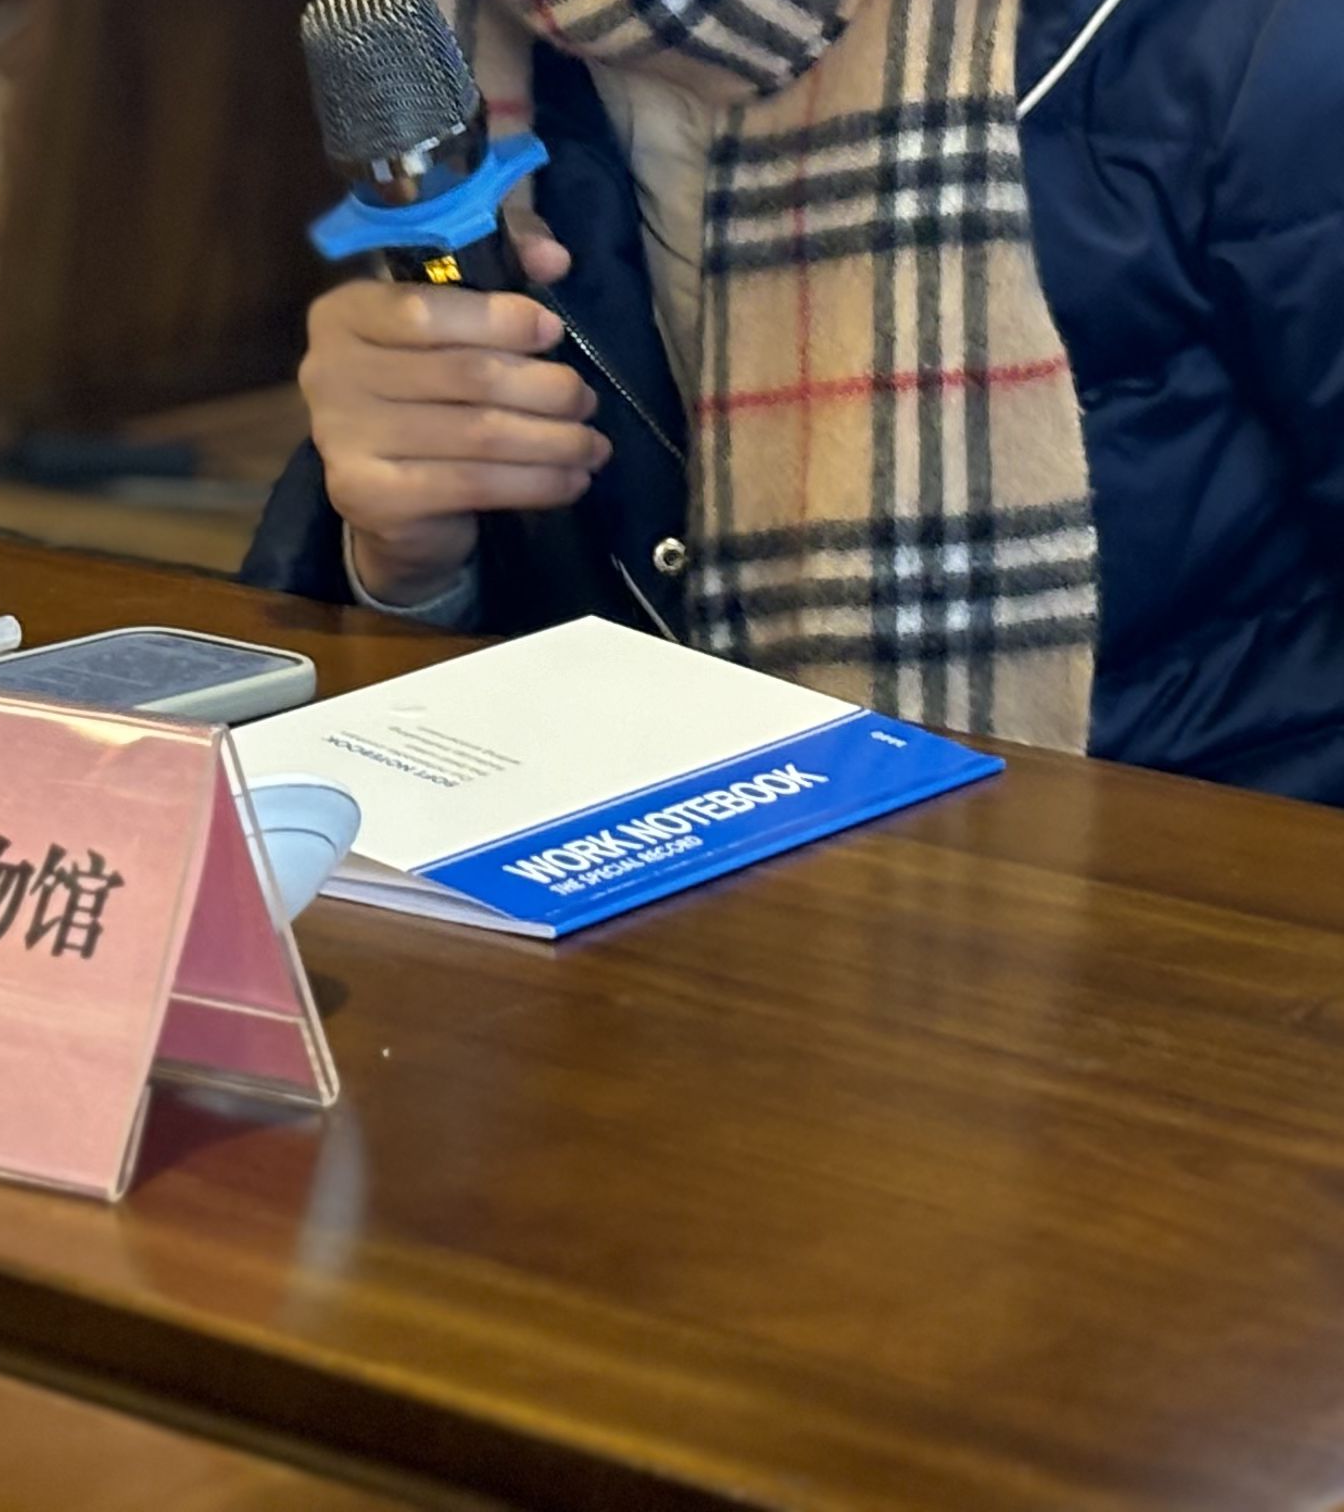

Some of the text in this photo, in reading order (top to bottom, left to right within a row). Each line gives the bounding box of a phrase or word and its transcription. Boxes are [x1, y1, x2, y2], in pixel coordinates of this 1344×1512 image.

[502, 829, 644, 884] WORK
[616, 763, 830, 845] NOTEBOOK
[549, 878, 586, 896] THE
[578, 856, 646, 885] SPECIAL
[637, 835, 704, 863] RECORD
